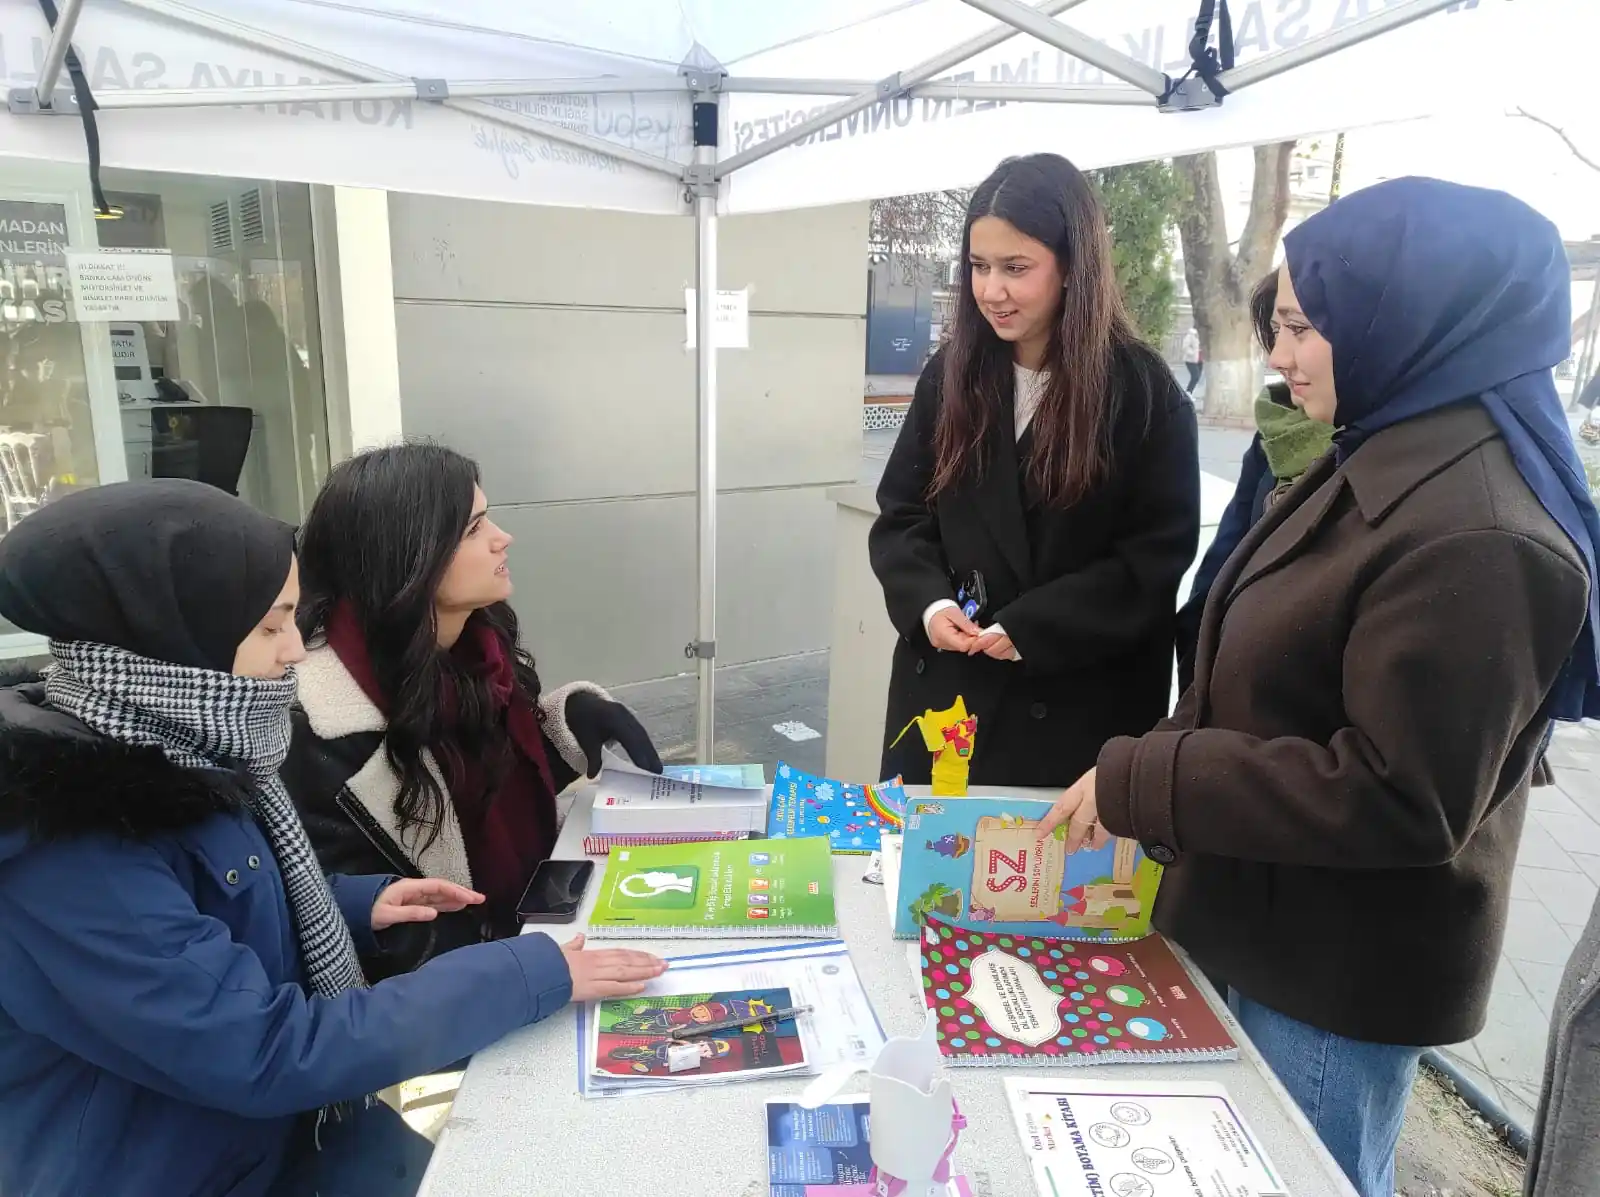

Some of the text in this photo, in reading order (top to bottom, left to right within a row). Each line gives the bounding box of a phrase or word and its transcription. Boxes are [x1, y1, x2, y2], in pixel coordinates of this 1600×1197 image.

[986, 849, 1028, 893] SZ
[1056, 1097, 1078, 1130] KİTABI
[1069, 1130, 1095, 1171] BOYAMA
